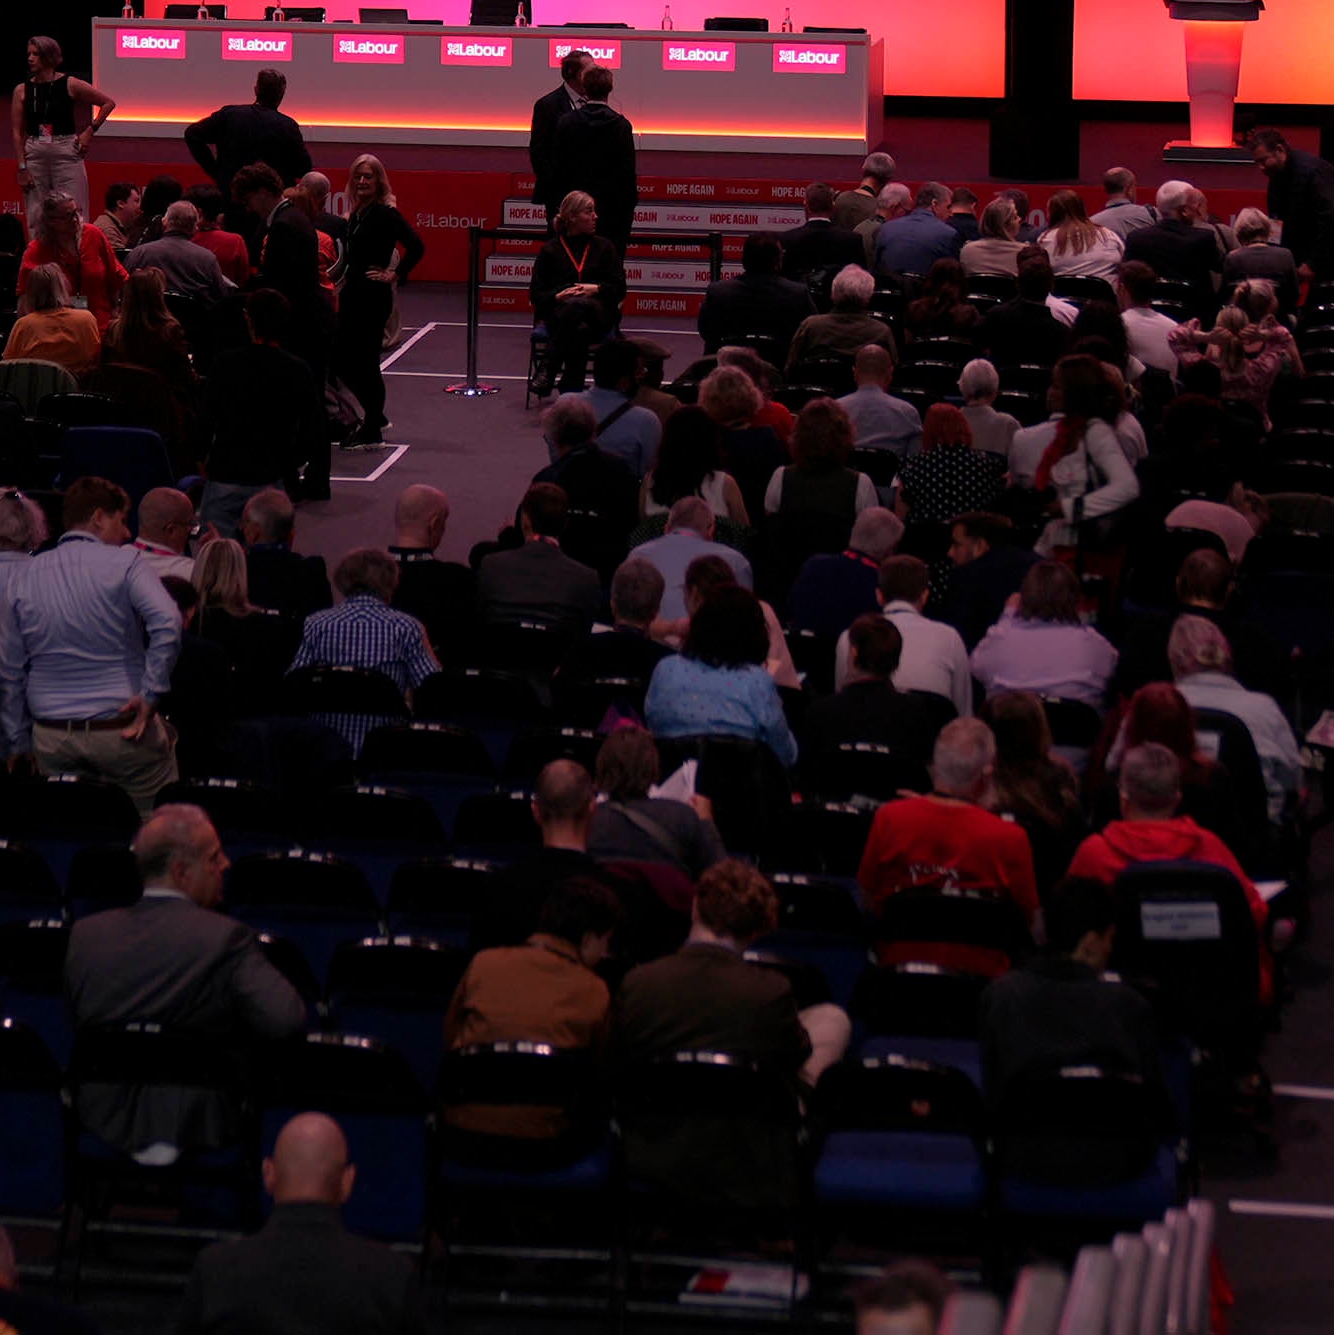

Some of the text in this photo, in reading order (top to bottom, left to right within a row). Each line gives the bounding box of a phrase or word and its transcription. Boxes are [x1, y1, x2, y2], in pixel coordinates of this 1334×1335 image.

[133, 35, 180, 49] Labour
[240, 38, 287, 52] Labour
[350, 41, 398, 54] Labour
[459, 43, 507, 57] Labour
[680, 48, 729, 62] Labour
[790, 50, 840, 64] Labour
[667, 183, 688, 195] HOPE
[689, 184, 714, 196] AGAIN
[771, 186, 793, 198] HOPE
[509, 208, 531, 219] HOPE
[709, 214, 731, 225] HOPE
[732, 214, 758, 225] AGAIN
[431, 213, 488, 230] Labour
[491, 265, 532, 276] HOPE AGA
[637, 299, 687, 312] HOPE AGAIN
